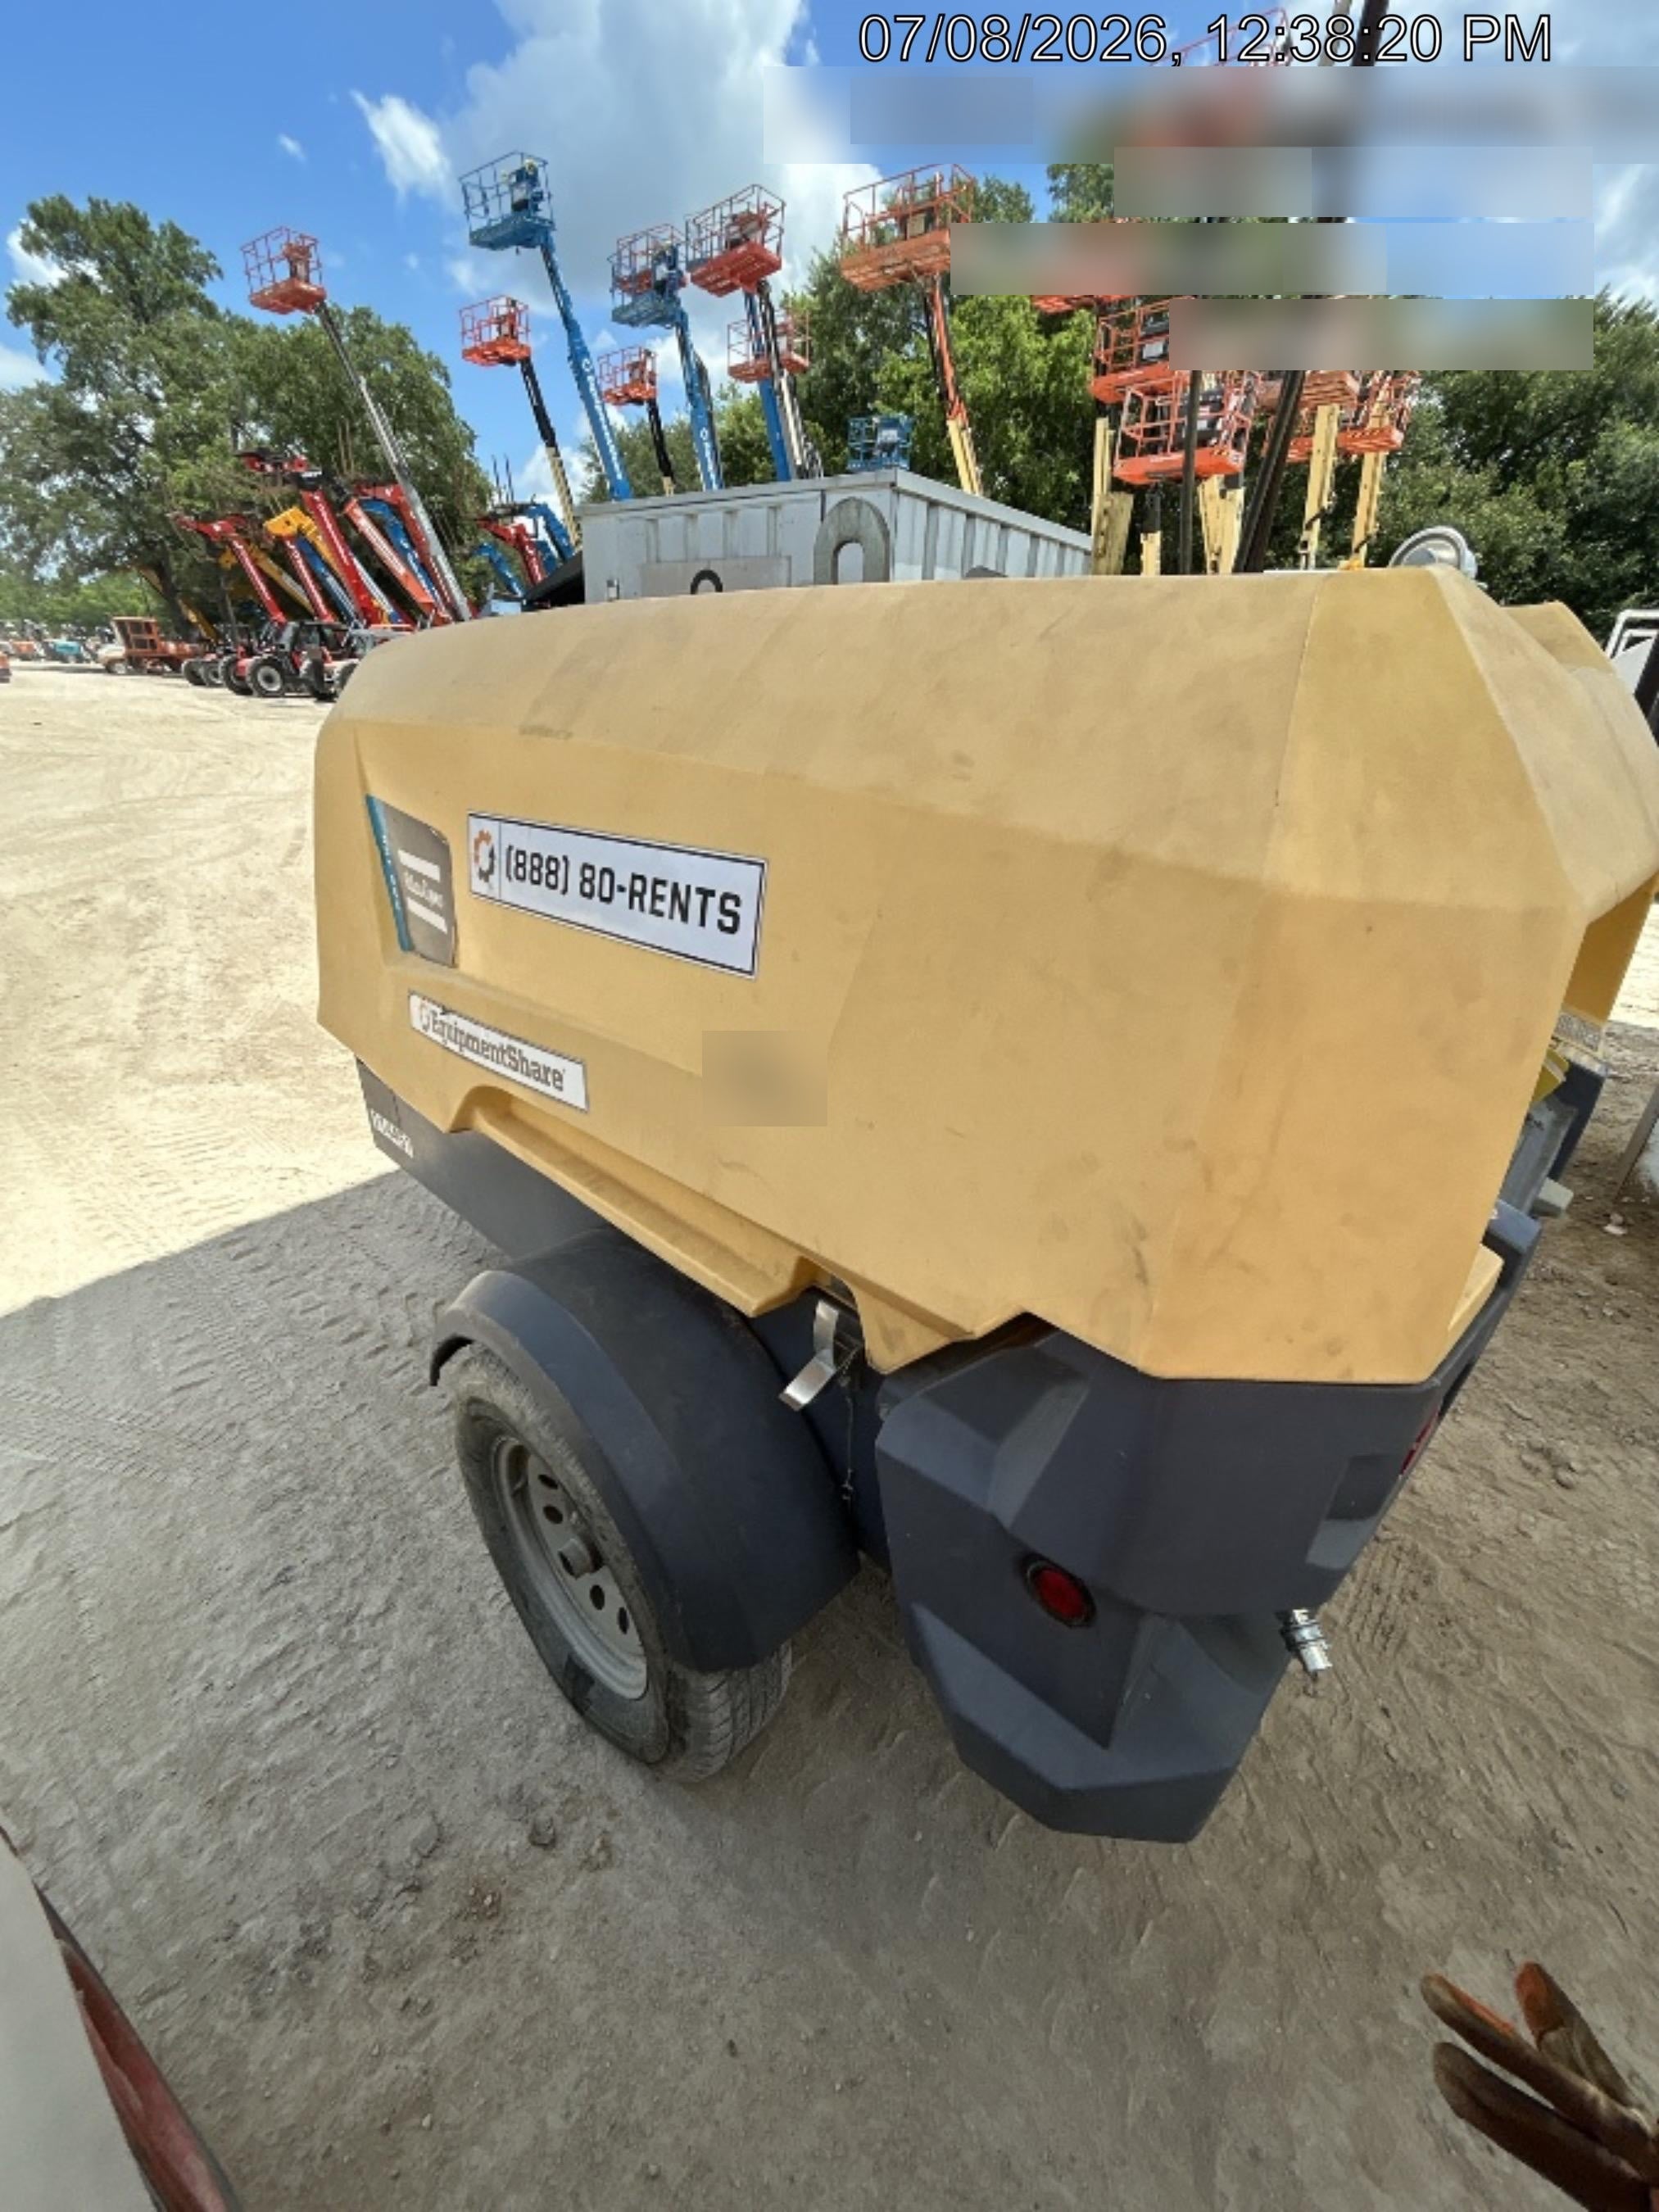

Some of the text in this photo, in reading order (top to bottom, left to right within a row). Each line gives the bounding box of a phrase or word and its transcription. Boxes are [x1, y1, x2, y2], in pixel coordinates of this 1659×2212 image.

[505, 844, 569, 895] (888)
[578, 863, 743, 936] 80-RENTS
[431, 1009, 565, 1092] EquipmentShare
